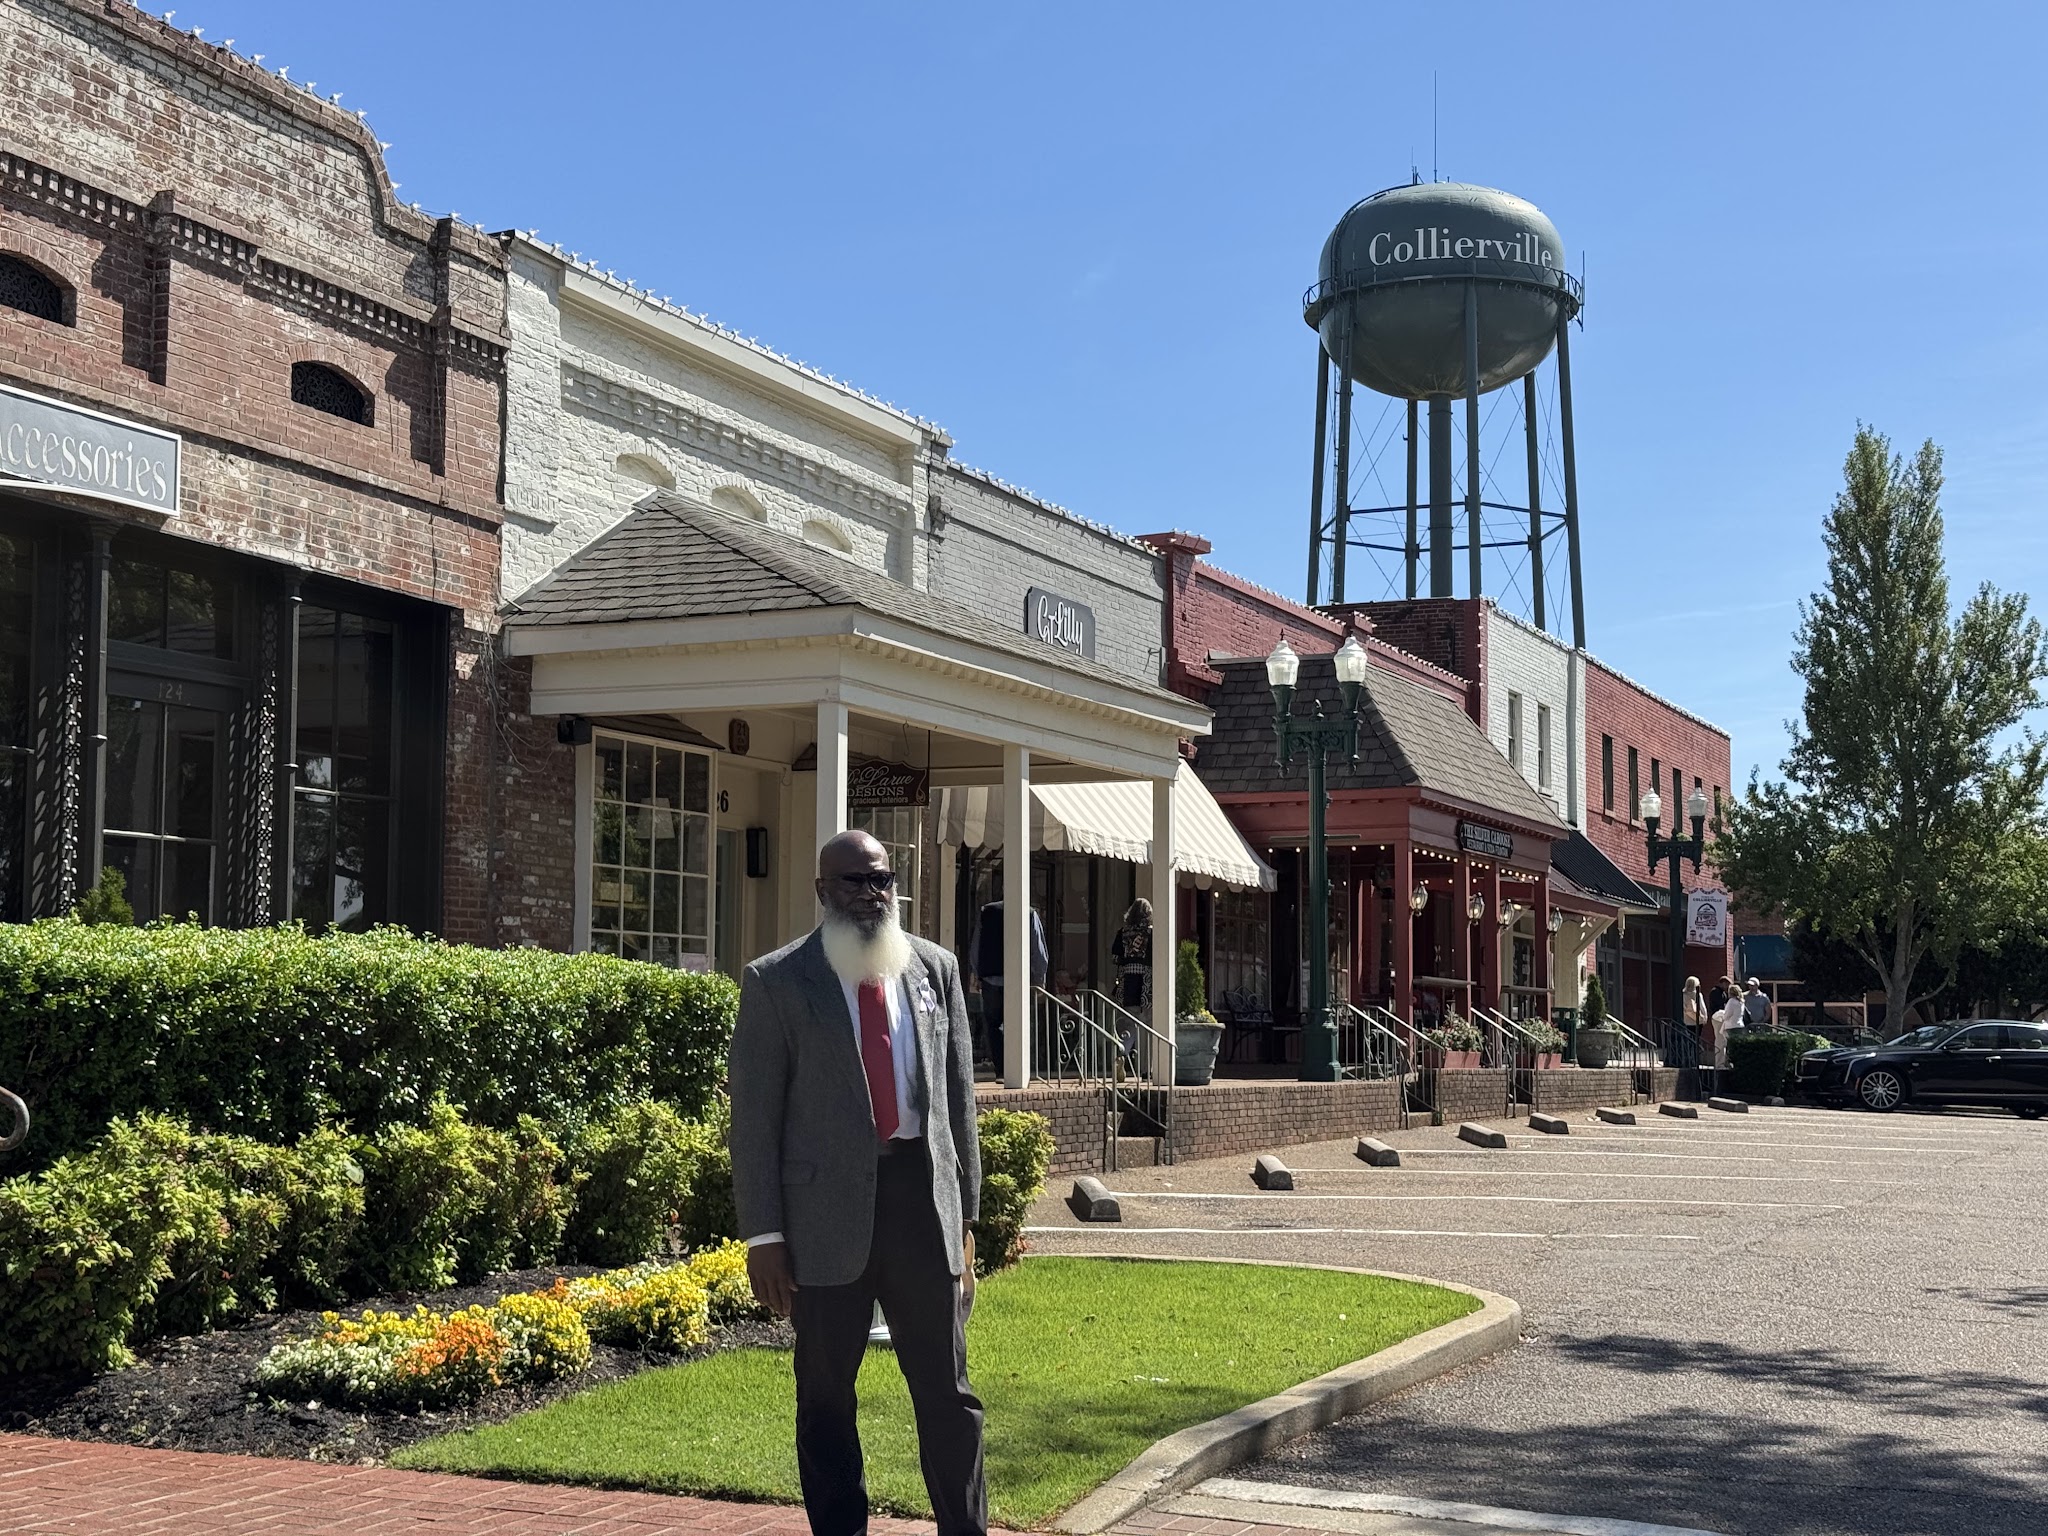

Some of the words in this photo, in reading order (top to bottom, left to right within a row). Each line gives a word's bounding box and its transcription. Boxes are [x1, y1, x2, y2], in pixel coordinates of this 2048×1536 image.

[1369, 227, 1552, 269] Collierville
[0, 423, 167, 501] ccessories
[159, 682, 183, 701] 124
[847, 786, 904, 797] DESIGNS
[852, 797, 880, 805] gracious
[881, 796, 909, 804] interiors
[1463, 823, 1474, 838] THE
